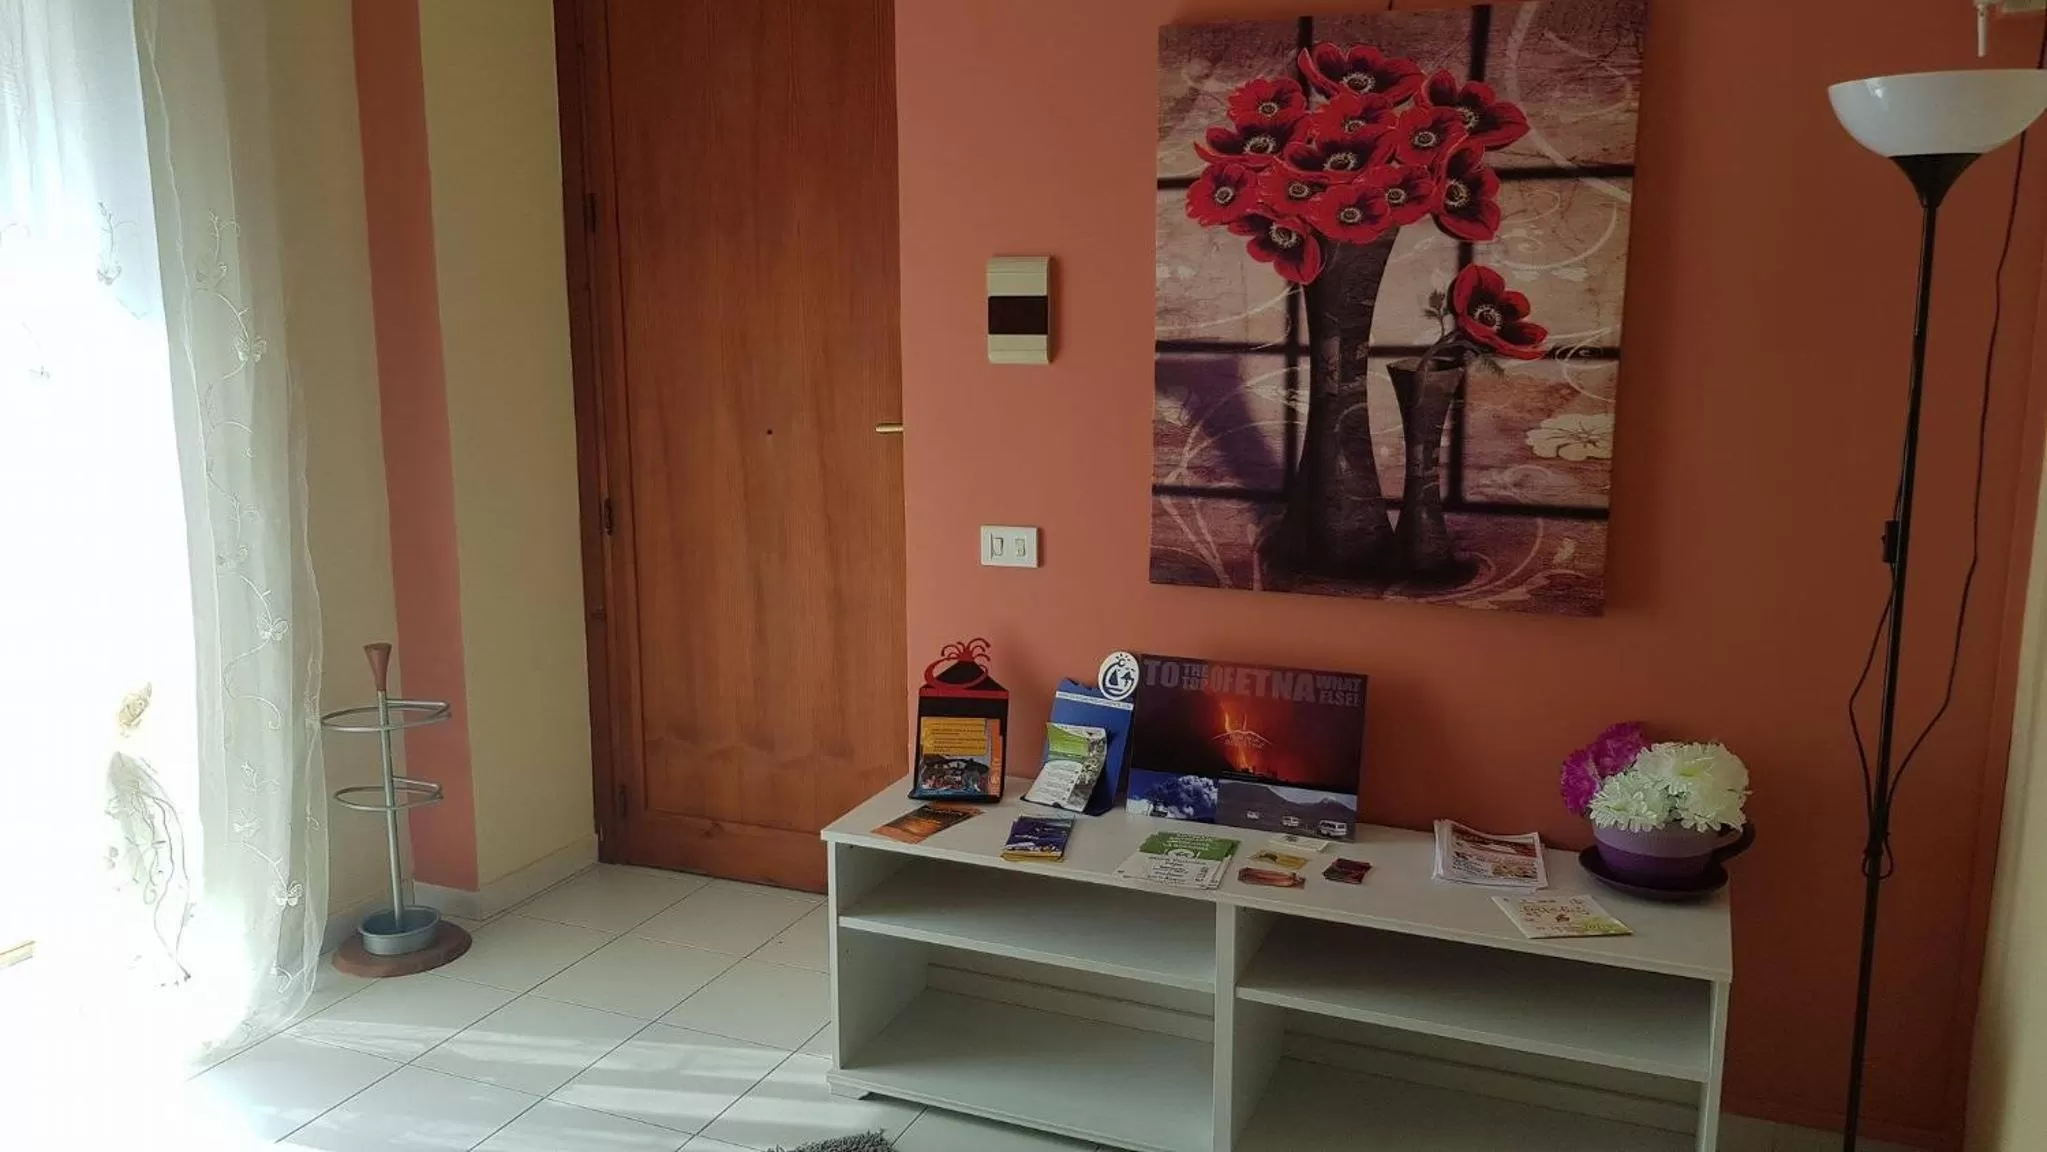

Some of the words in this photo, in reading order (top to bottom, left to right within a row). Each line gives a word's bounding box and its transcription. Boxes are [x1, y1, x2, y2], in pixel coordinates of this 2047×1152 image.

[1143, 659, 1180, 688] TO
[1182, 663, 1209, 677] THE
[1316, 675, 1362, 692] WHAT
